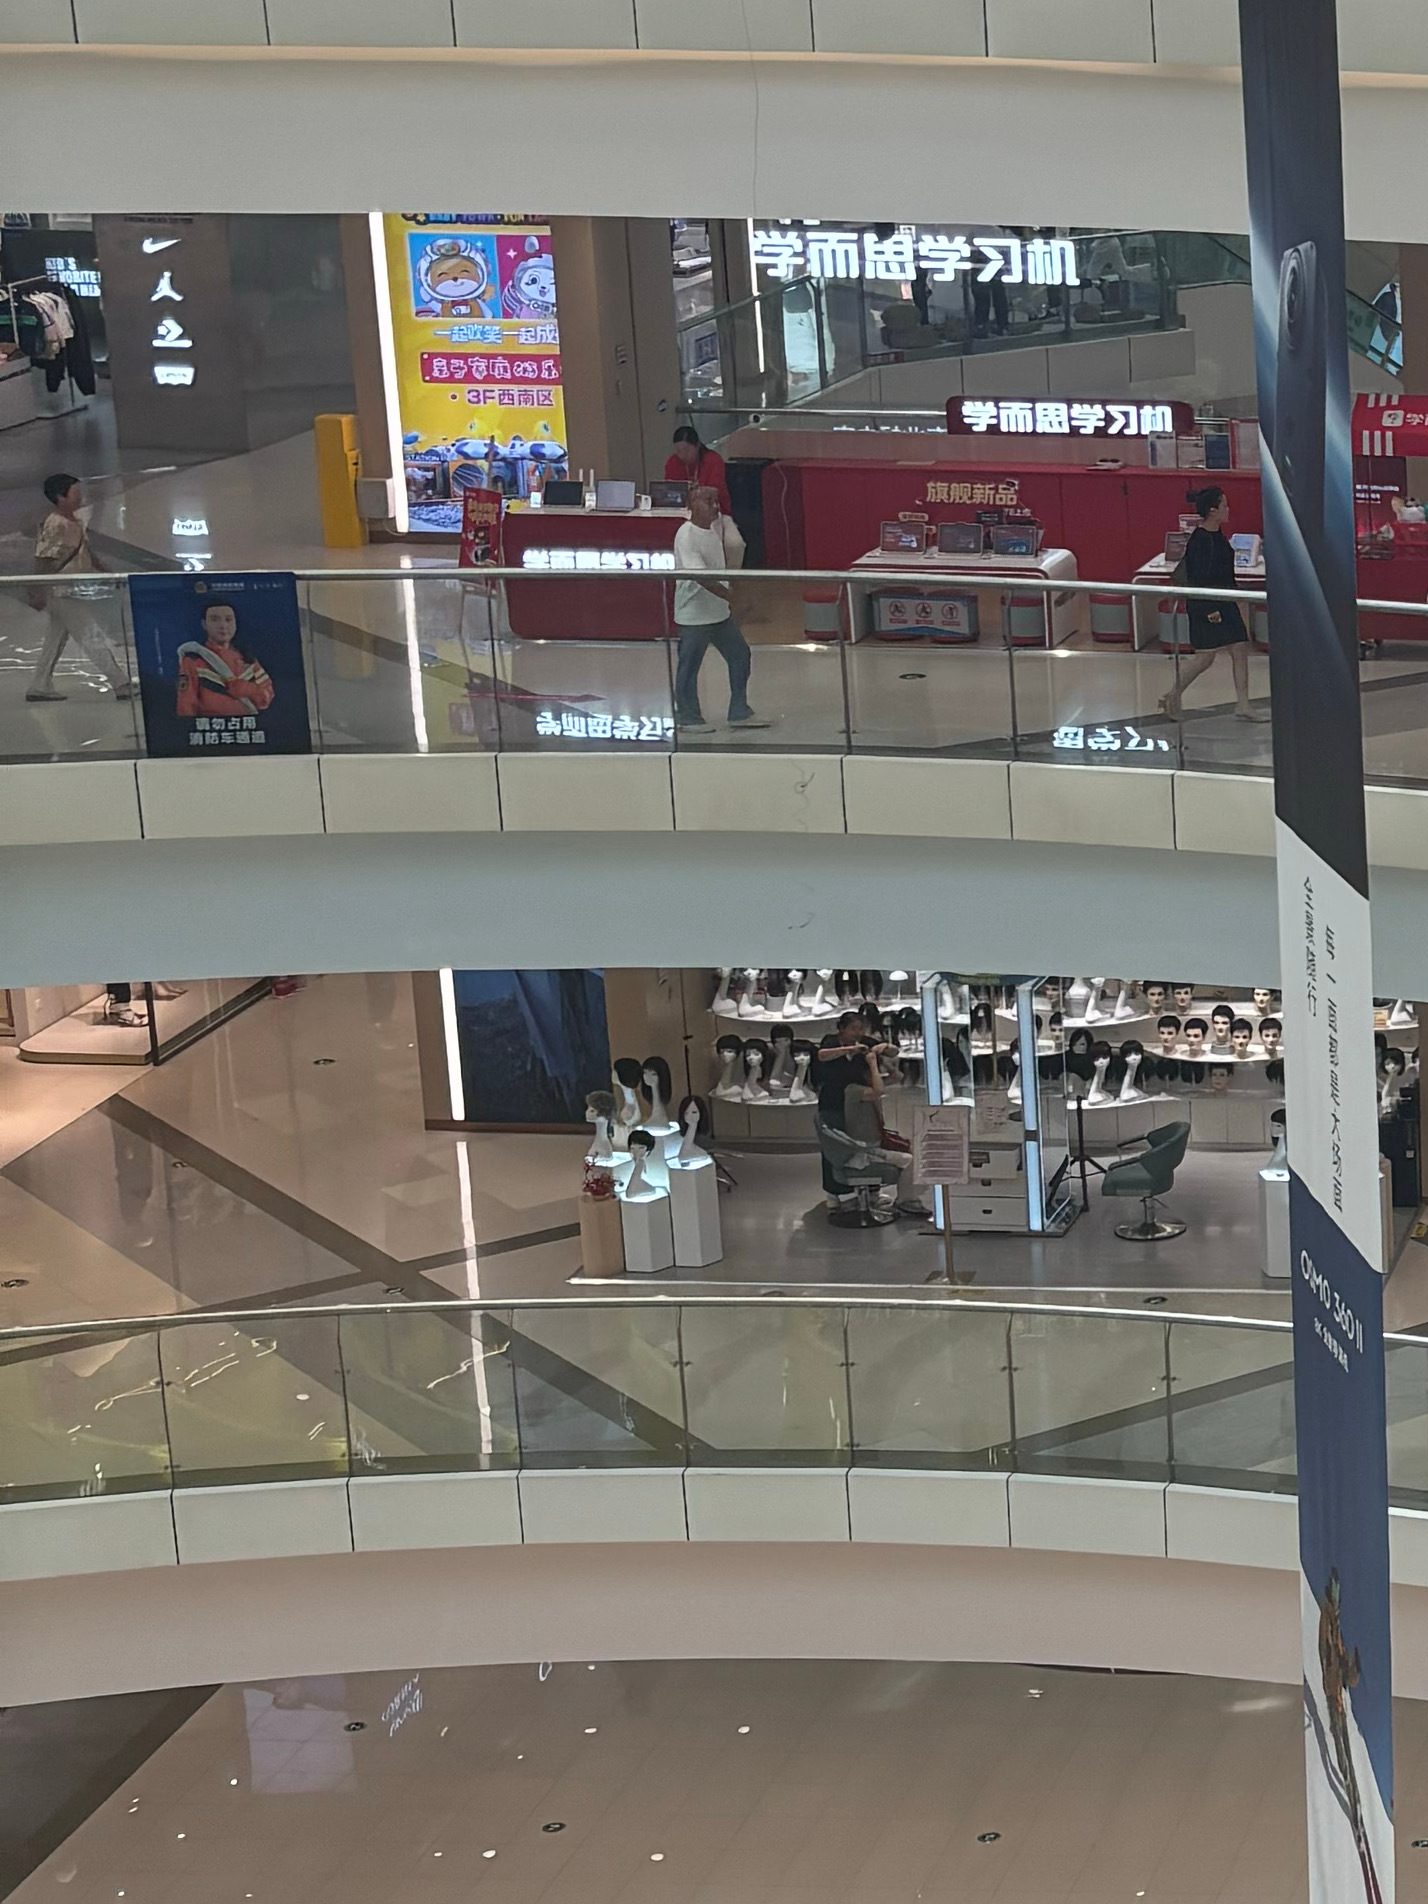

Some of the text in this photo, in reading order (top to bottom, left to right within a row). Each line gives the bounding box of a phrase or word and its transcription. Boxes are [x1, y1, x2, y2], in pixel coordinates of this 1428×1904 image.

[752, 231, 1081, 287] 学而思学习机
[466, 389, 554, 407] 3F西南区
[962, 401, 1173, 435] 学而思学习机
